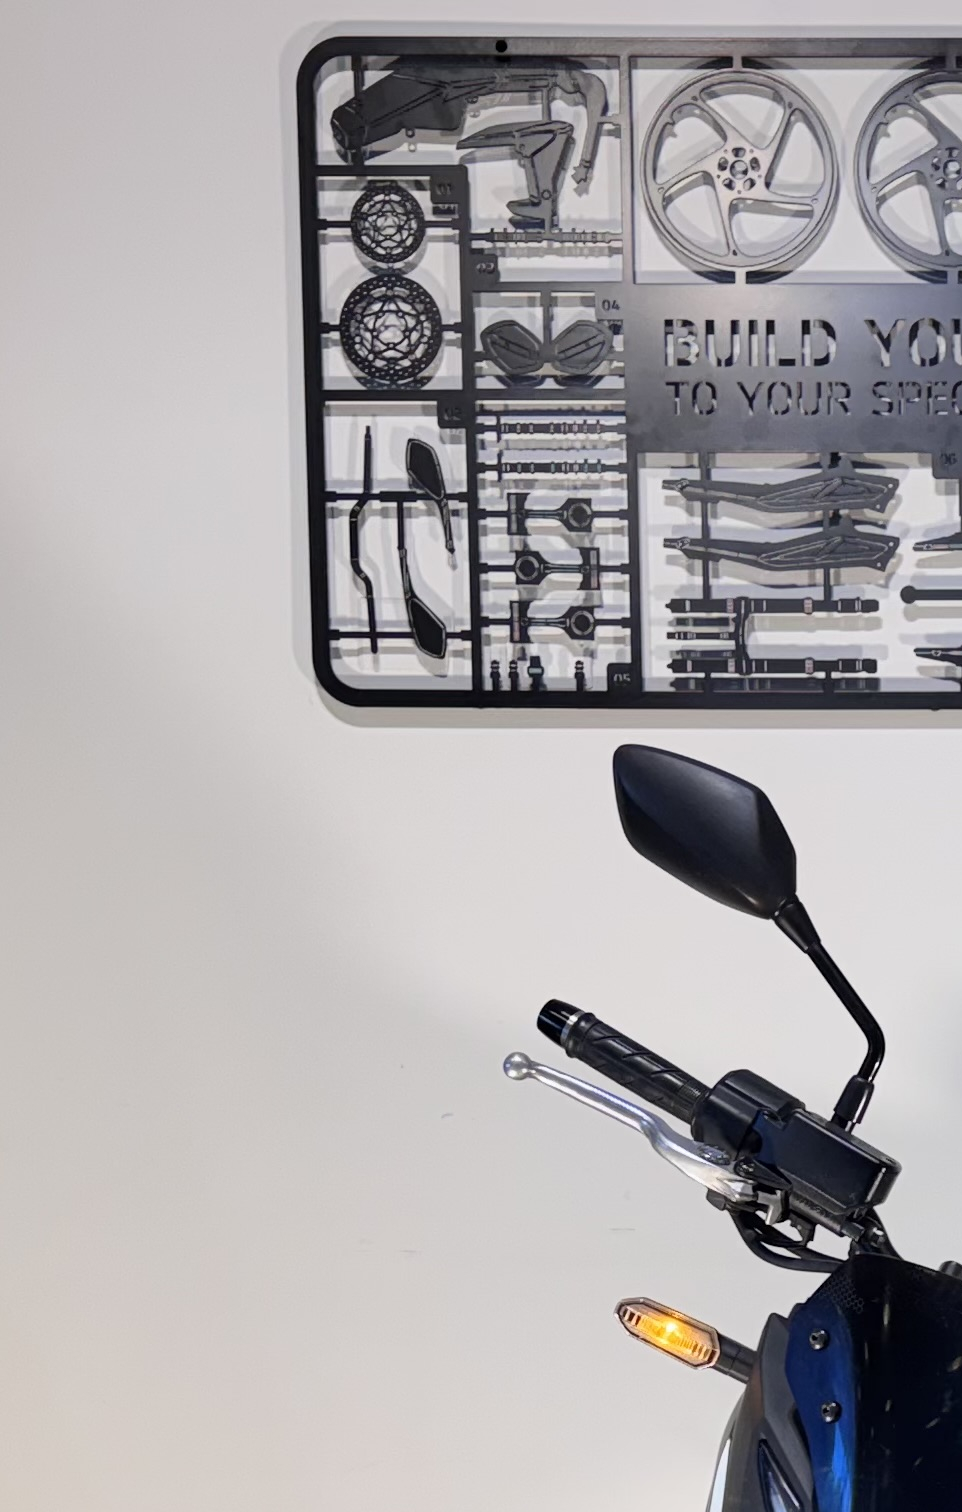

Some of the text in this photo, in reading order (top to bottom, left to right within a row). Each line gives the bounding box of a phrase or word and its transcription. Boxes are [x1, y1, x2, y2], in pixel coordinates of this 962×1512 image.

[602, 299, 620, 311] 04
[663, 318, 838, 368] BUILD
[665, 380, 718, 416] TO
[737, 380, 852, 416] YOUR
[613, 672, 631, 685] 05
